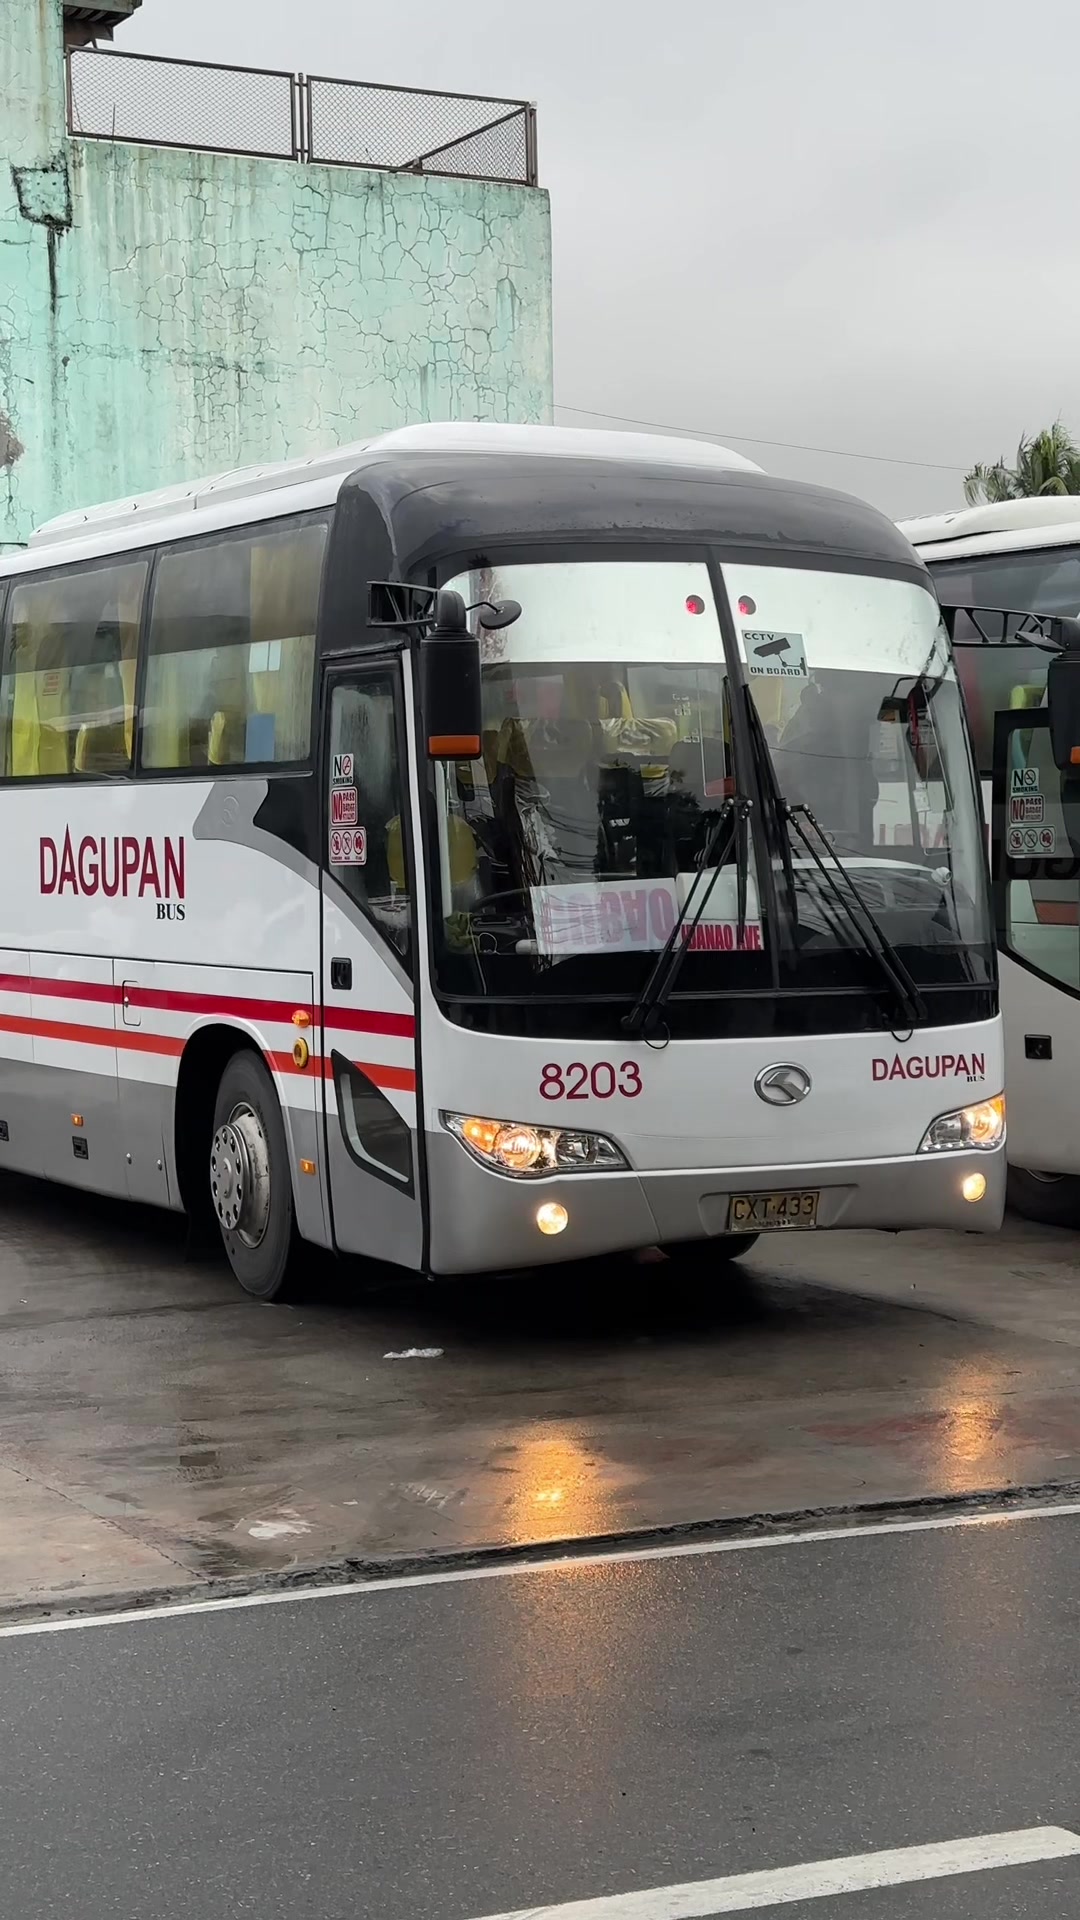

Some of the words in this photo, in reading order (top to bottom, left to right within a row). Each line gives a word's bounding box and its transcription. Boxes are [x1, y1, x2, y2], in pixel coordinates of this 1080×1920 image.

[744, 632, 775, 641] CCTV
[750, 666, 764, 674] ON
[766, 667, 801, 676] BOARD
[342, 791, 355, 802] PASS
[1025, 797, 1042, 806] PASS
[1012, 798, 1025, 821] NO
[39, 823, 185, 899] DAGUPAN
[155, 903, 186, 921] BUS
[871, 1053, 985, 1081] DAGUPAN
[539, 1060, 643, 1100] 8203
[966, 1074, 986, 1083] BUS
